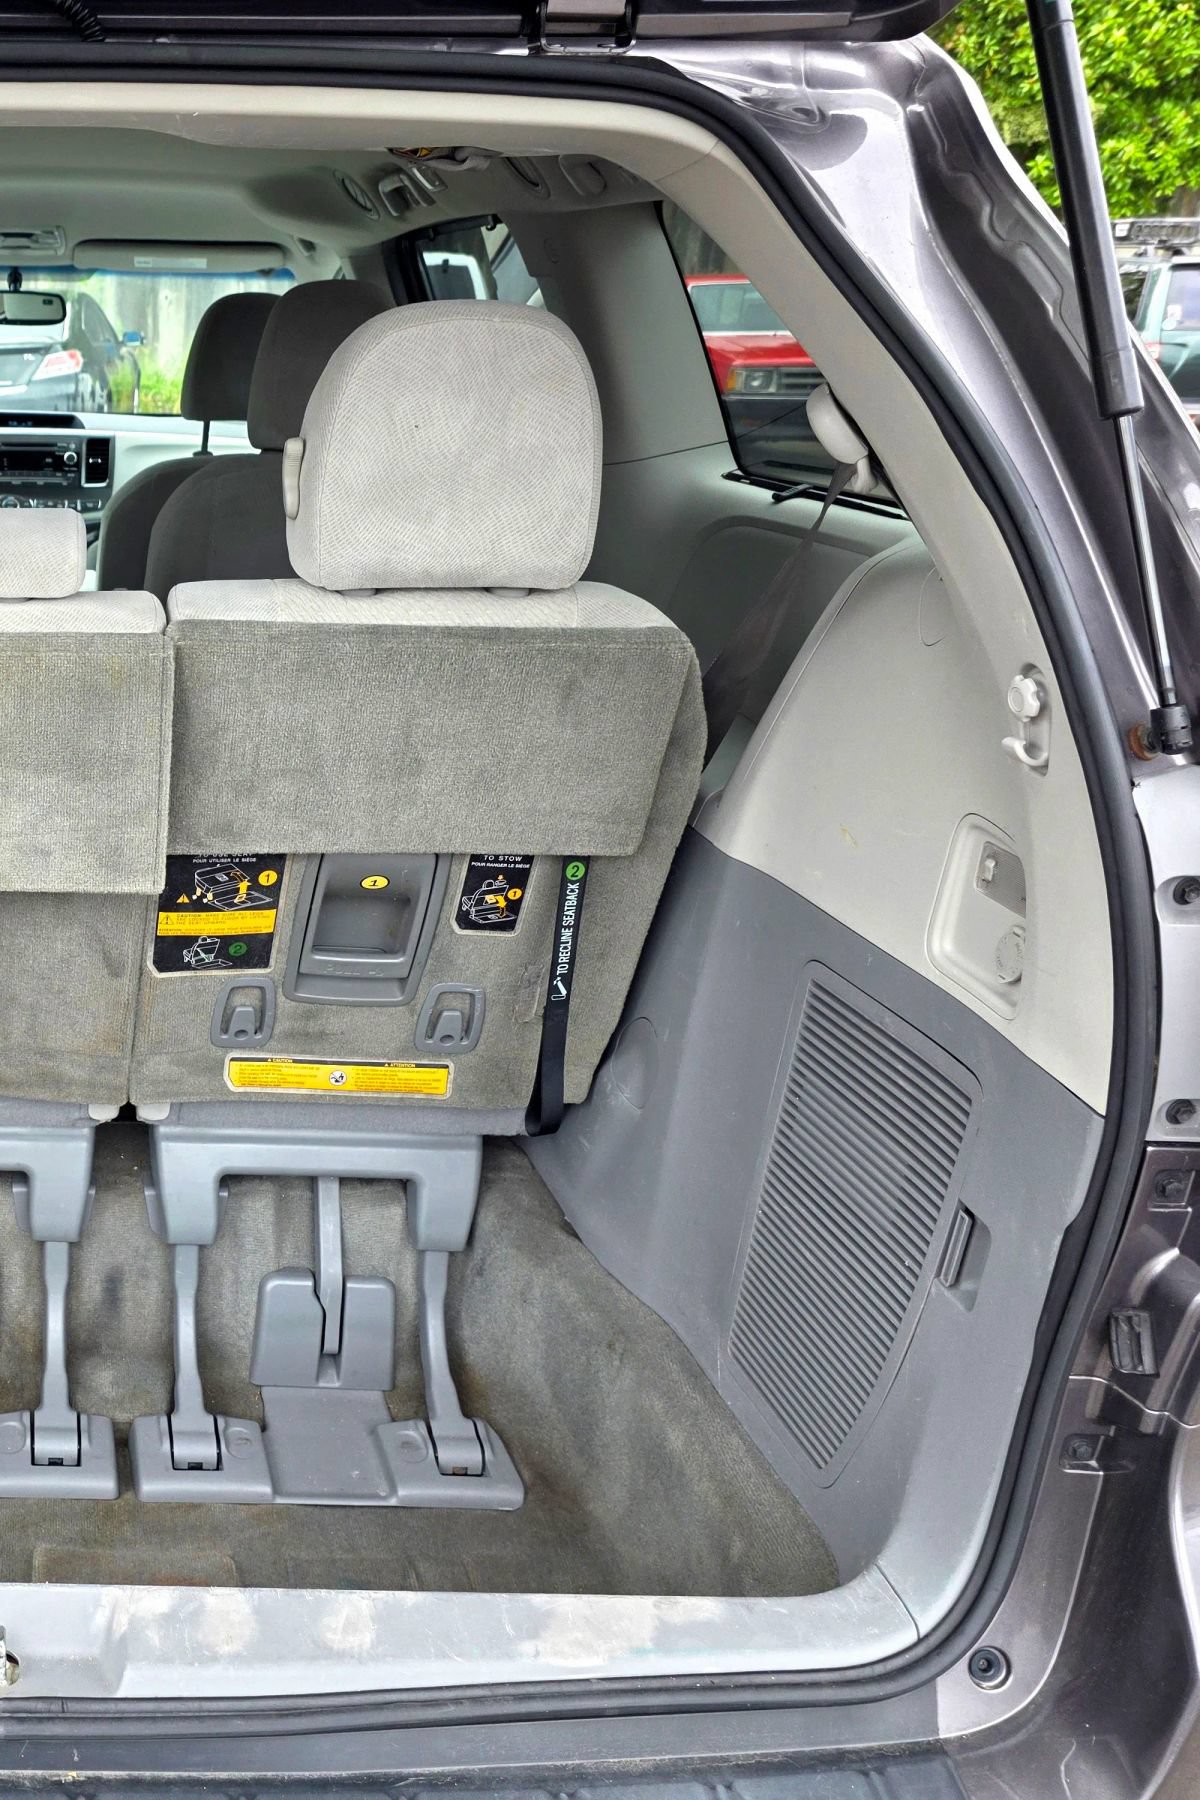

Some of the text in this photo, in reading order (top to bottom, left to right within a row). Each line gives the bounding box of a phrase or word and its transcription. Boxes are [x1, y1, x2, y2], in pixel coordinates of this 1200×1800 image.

[570, 864, 580, 878] 2
[556, 883, 580, 975] TO RECLINE SEATBACK
